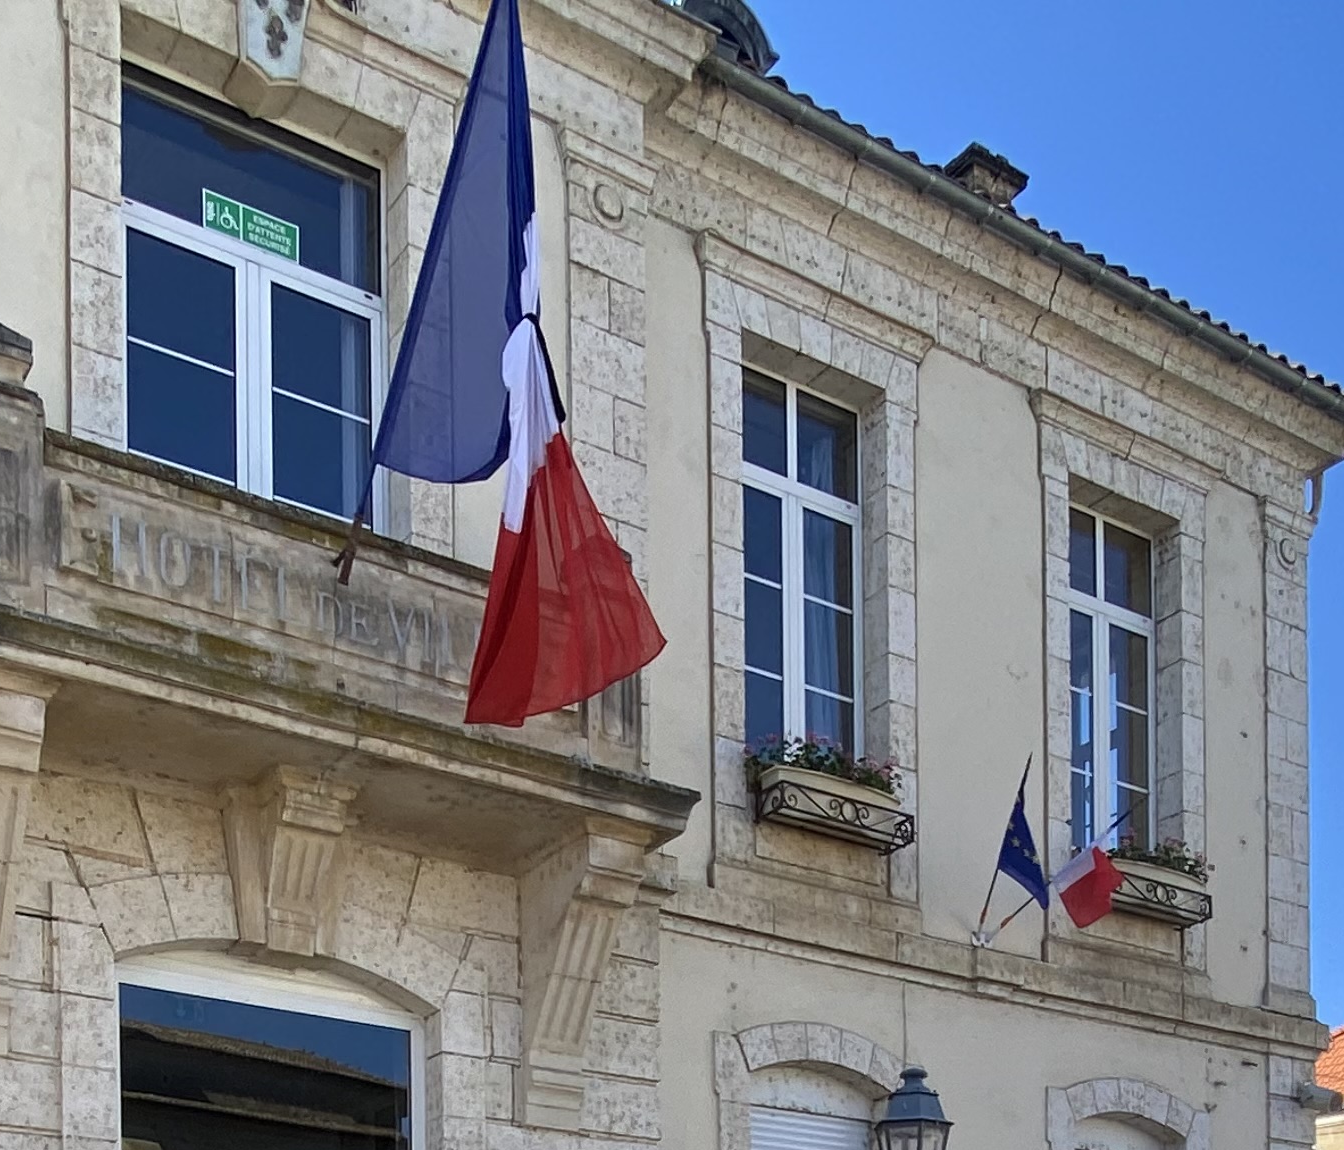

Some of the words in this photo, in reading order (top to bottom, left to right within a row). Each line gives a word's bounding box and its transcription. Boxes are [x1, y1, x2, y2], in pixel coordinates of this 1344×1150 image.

[247, 222, 291, 246] D'ATTENTE
[253, 215, 286, 234] ESPACE
[314, 591, 379, 645] DE
